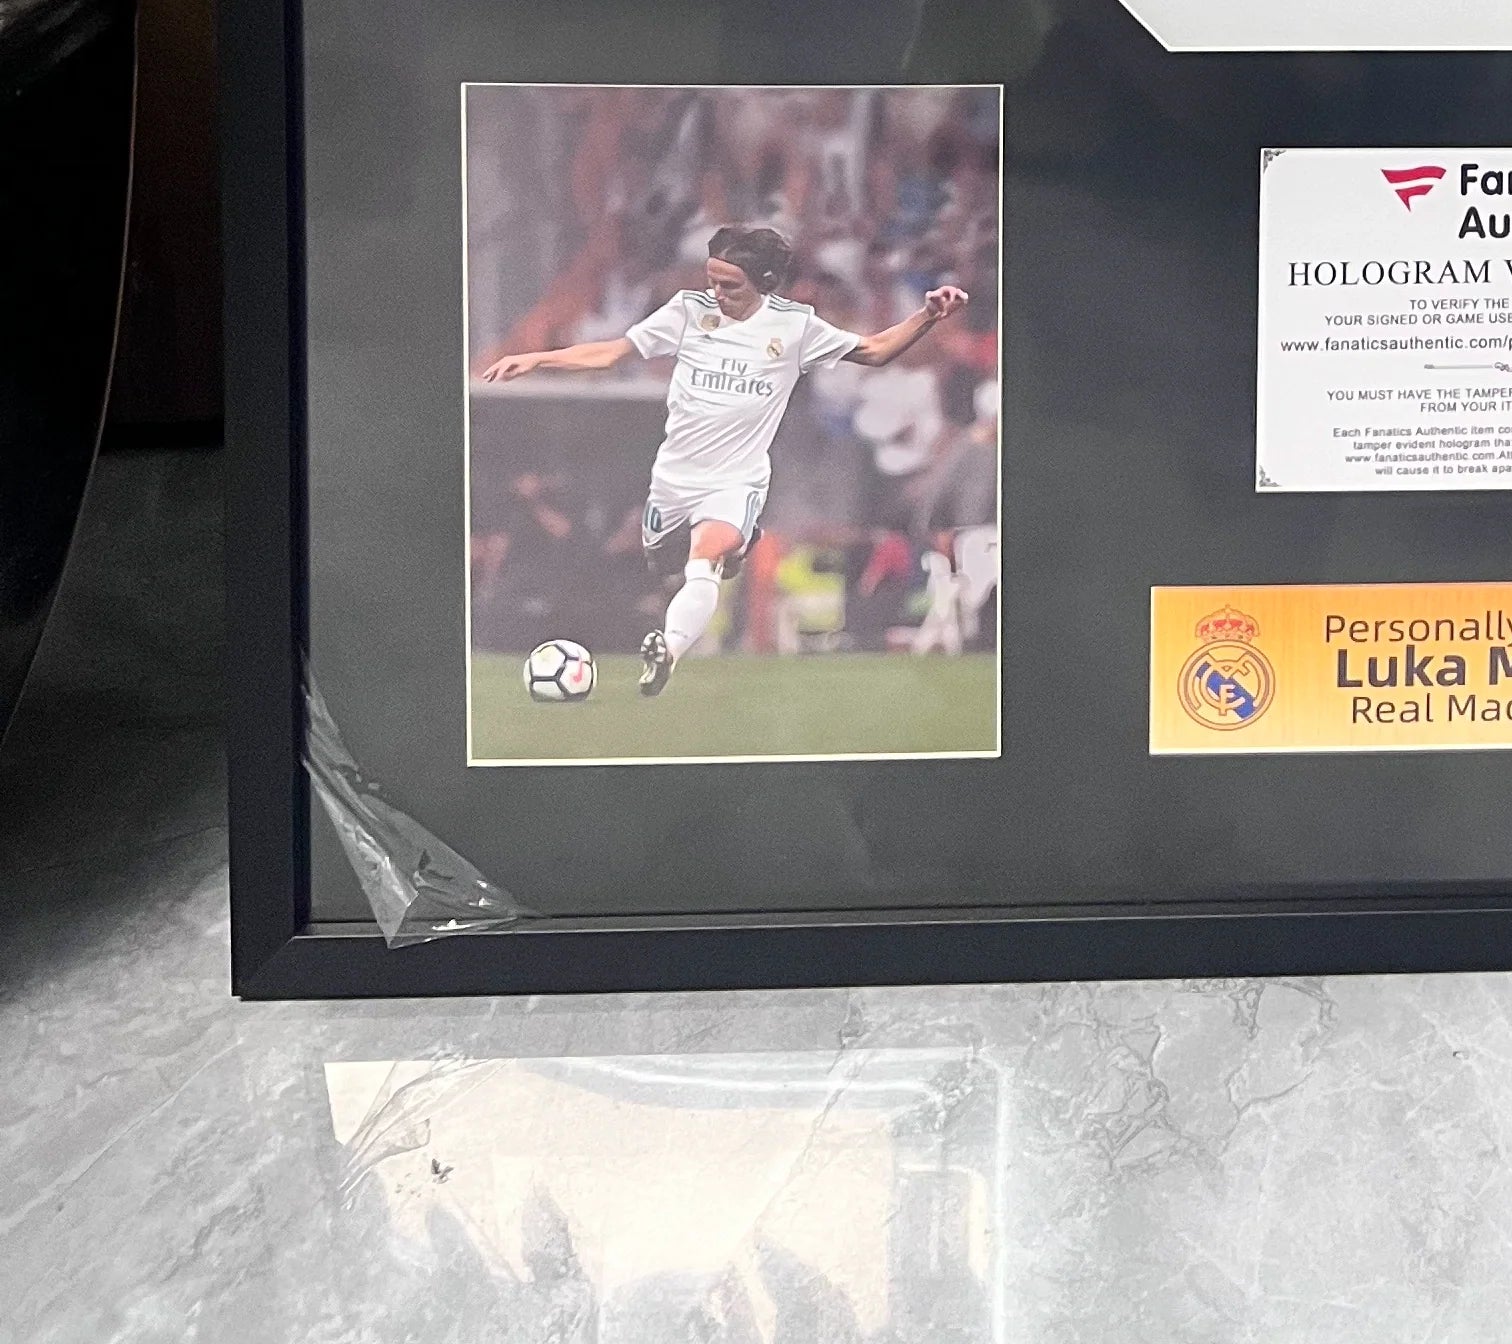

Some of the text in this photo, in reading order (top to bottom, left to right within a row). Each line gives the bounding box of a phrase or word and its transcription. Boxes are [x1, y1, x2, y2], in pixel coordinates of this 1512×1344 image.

[1288, 260, 1491, 286] HOLOGRAM
[1410, 300, 1426, 310] TO
[1432, 299, 1478, 310] VERIFY
[1485, 298, 1508, 309] THE
[1325, 315, 1362, 326] YOUR
[1367, 314, 1418, 325] SIGNED
[1422, 314, 1441, 324] OR
[1446, 313, 1484, 324] GAME
[721, 358, 748, 376] Fly
[1327, 391, 1353, 400] YOU
[1359, 390, 1393, 400] MUST
[1398, 389, 1431, 399] HAVE
[1437, 389, 1460, 399] THE
[1421, 402, 1456, 412] FROM
[1461, 401, 1496, 411] YOUR
[1337, 642, 1468, 689] Luka
[1351, 693, 1433, 724] Real
